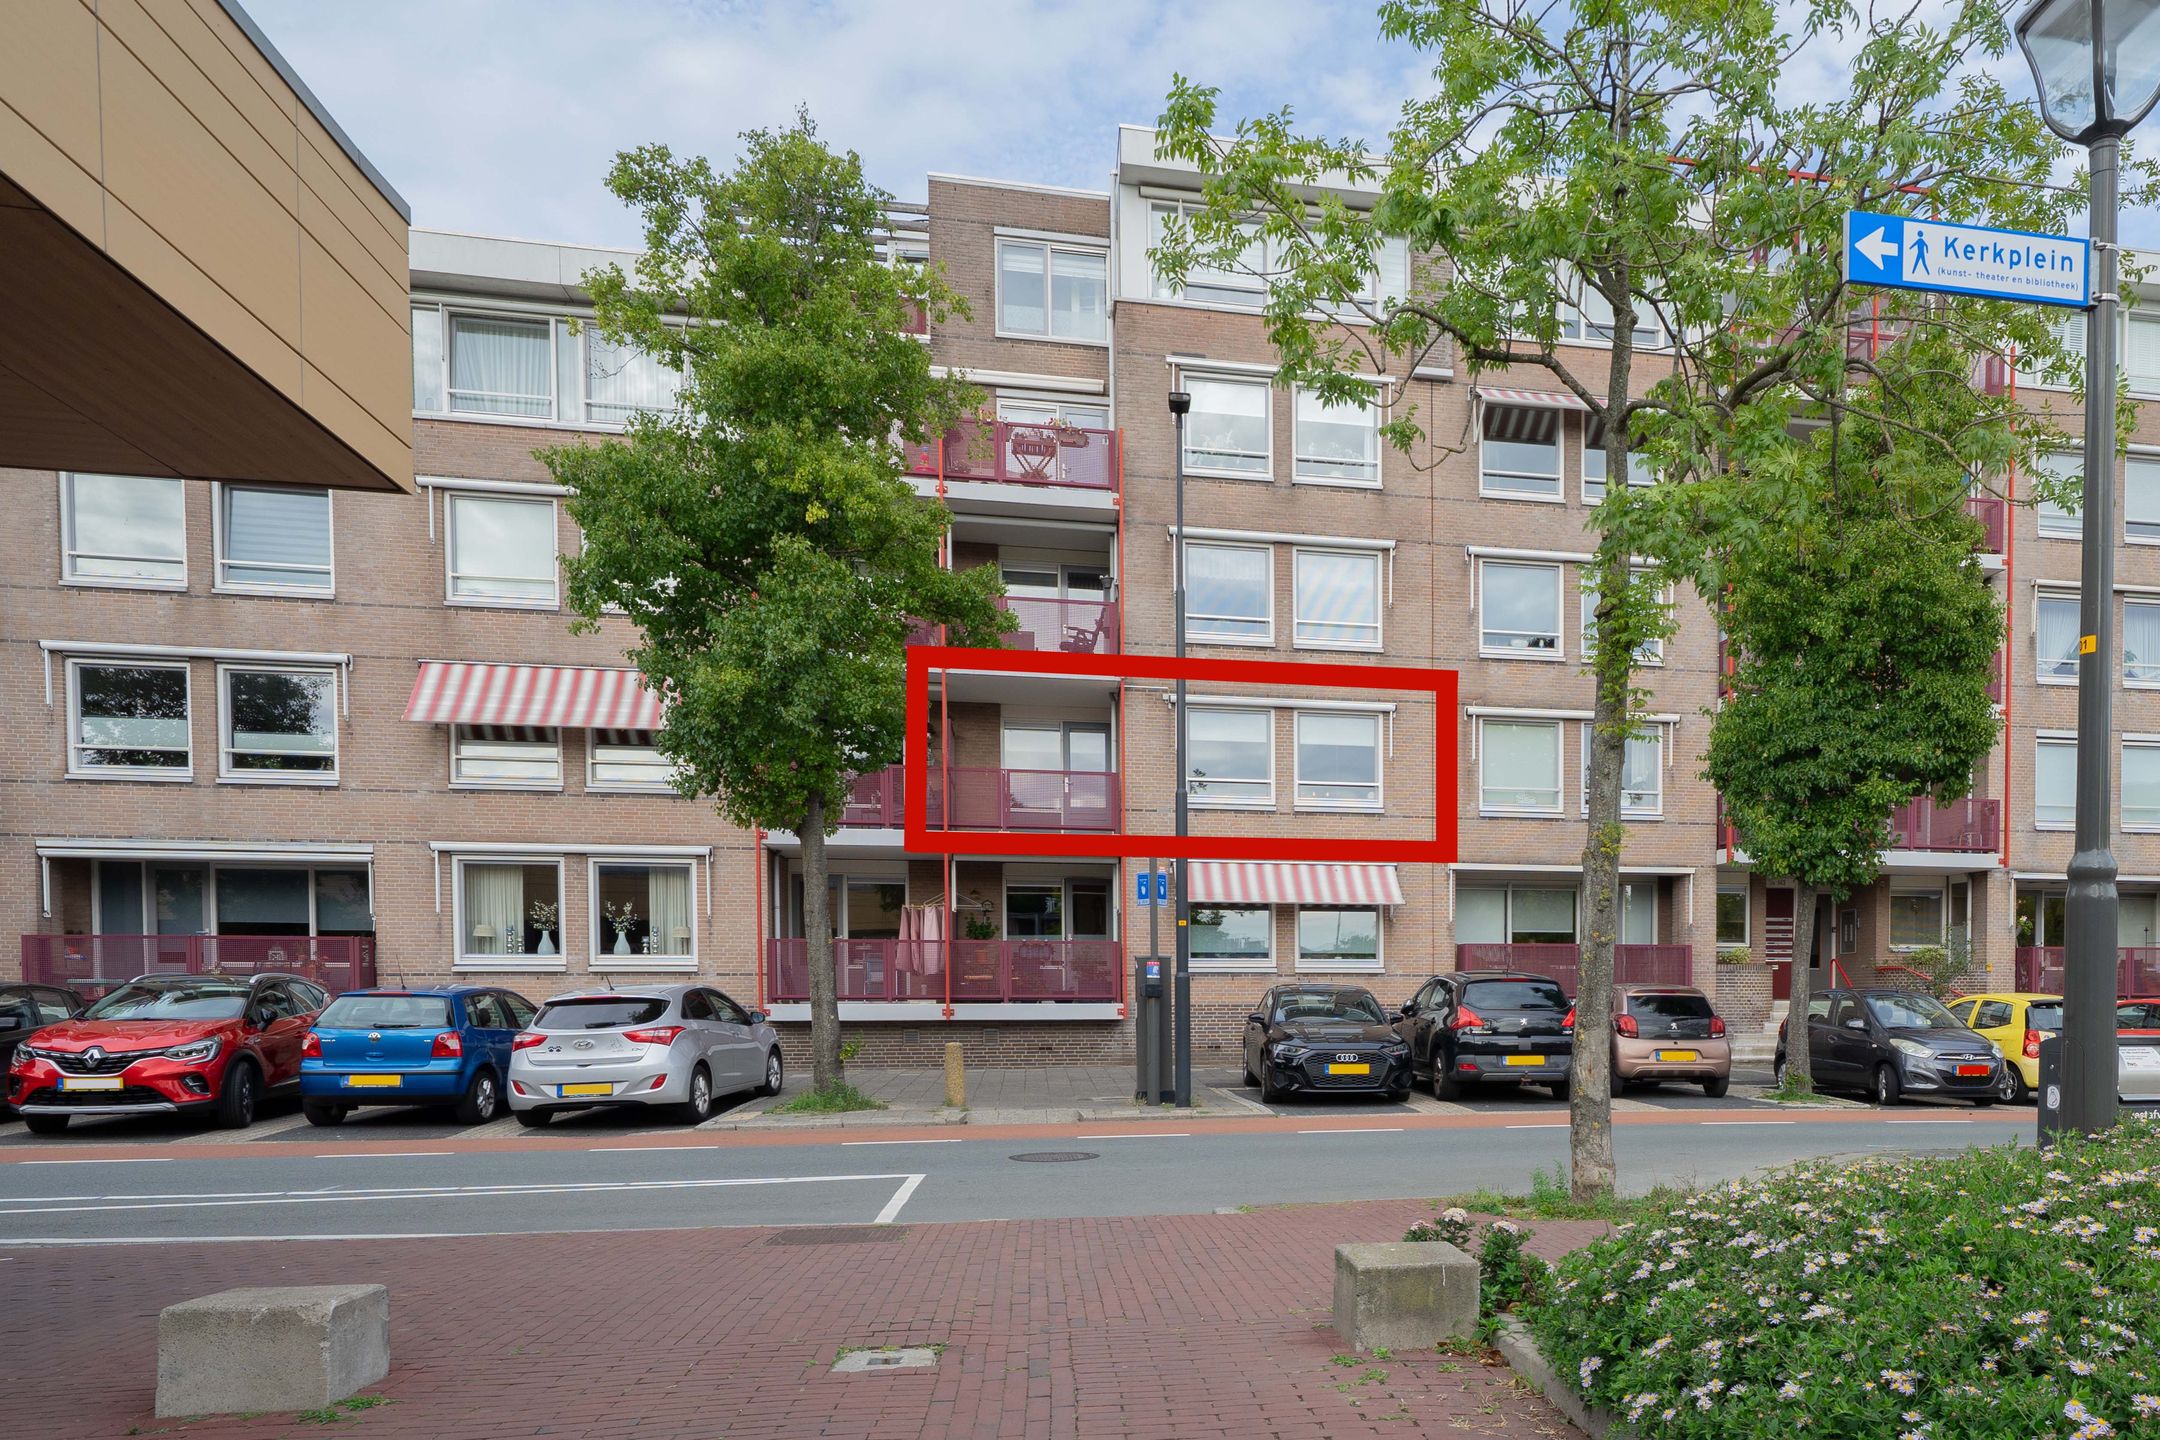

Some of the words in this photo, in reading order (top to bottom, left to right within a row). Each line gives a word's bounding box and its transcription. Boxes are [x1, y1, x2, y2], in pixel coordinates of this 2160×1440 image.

[1944, 236, 2073, 272] Kerkplein
[1938, 267, 1972, 278] (kunst-
[1976, 271, 2010, 282] theater
[2025, 277, 2079, 292] bibliotheek)
